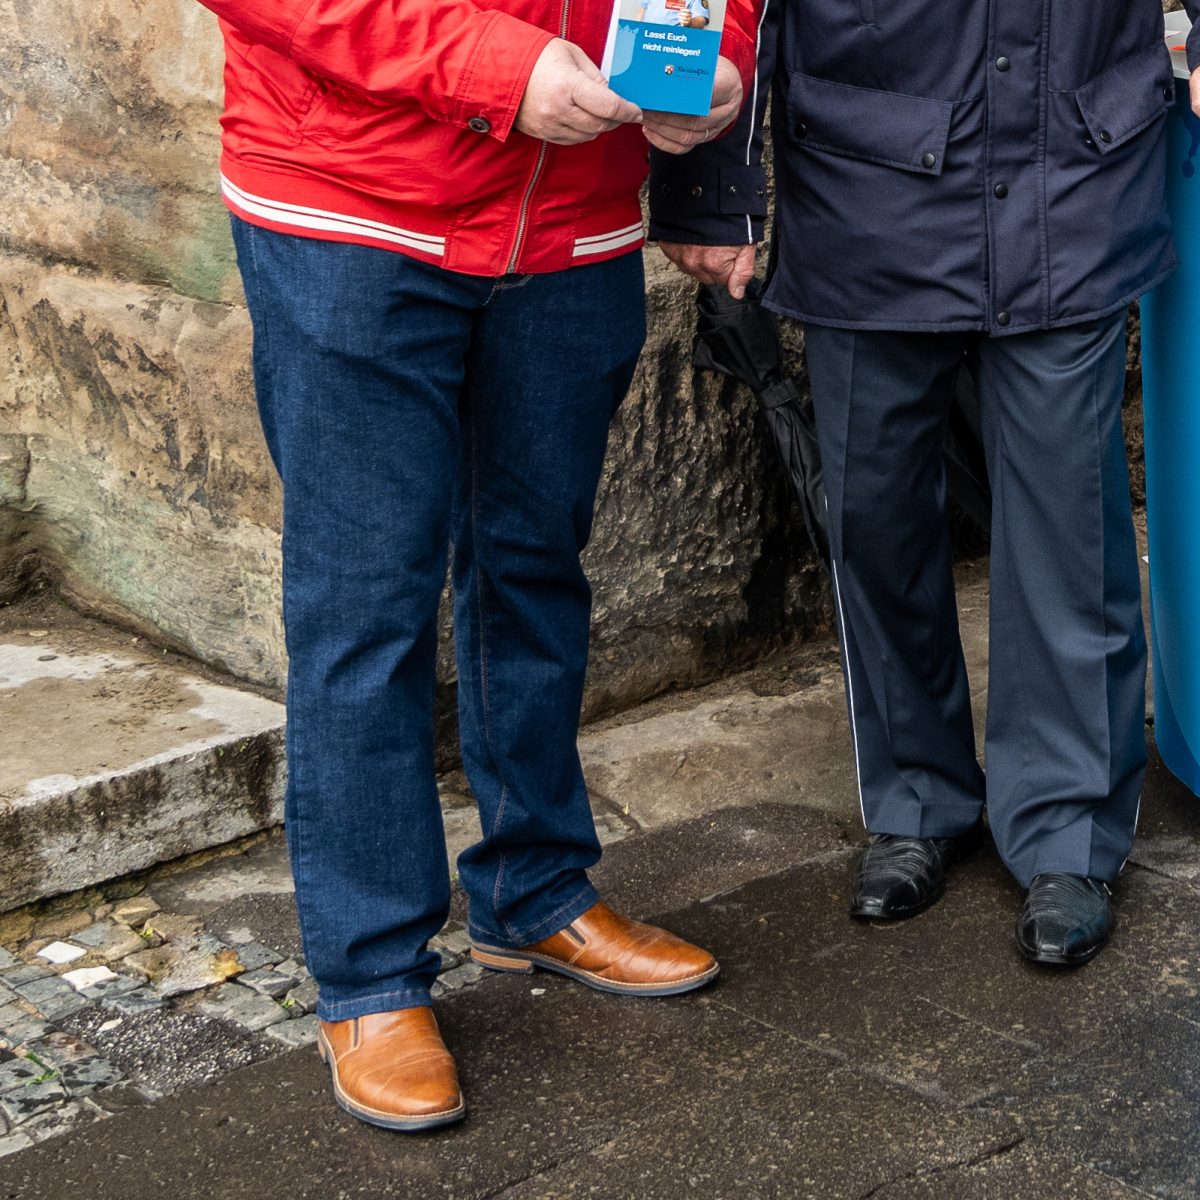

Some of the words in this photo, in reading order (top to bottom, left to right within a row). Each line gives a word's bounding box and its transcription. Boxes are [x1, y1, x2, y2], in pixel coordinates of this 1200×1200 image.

[644, 30, 666, 39] Lasst
[667, 33, 687, 42] Euch
[643, 43, 661, 51] nicht
[663, 46, 700, 56] reinlegen!
